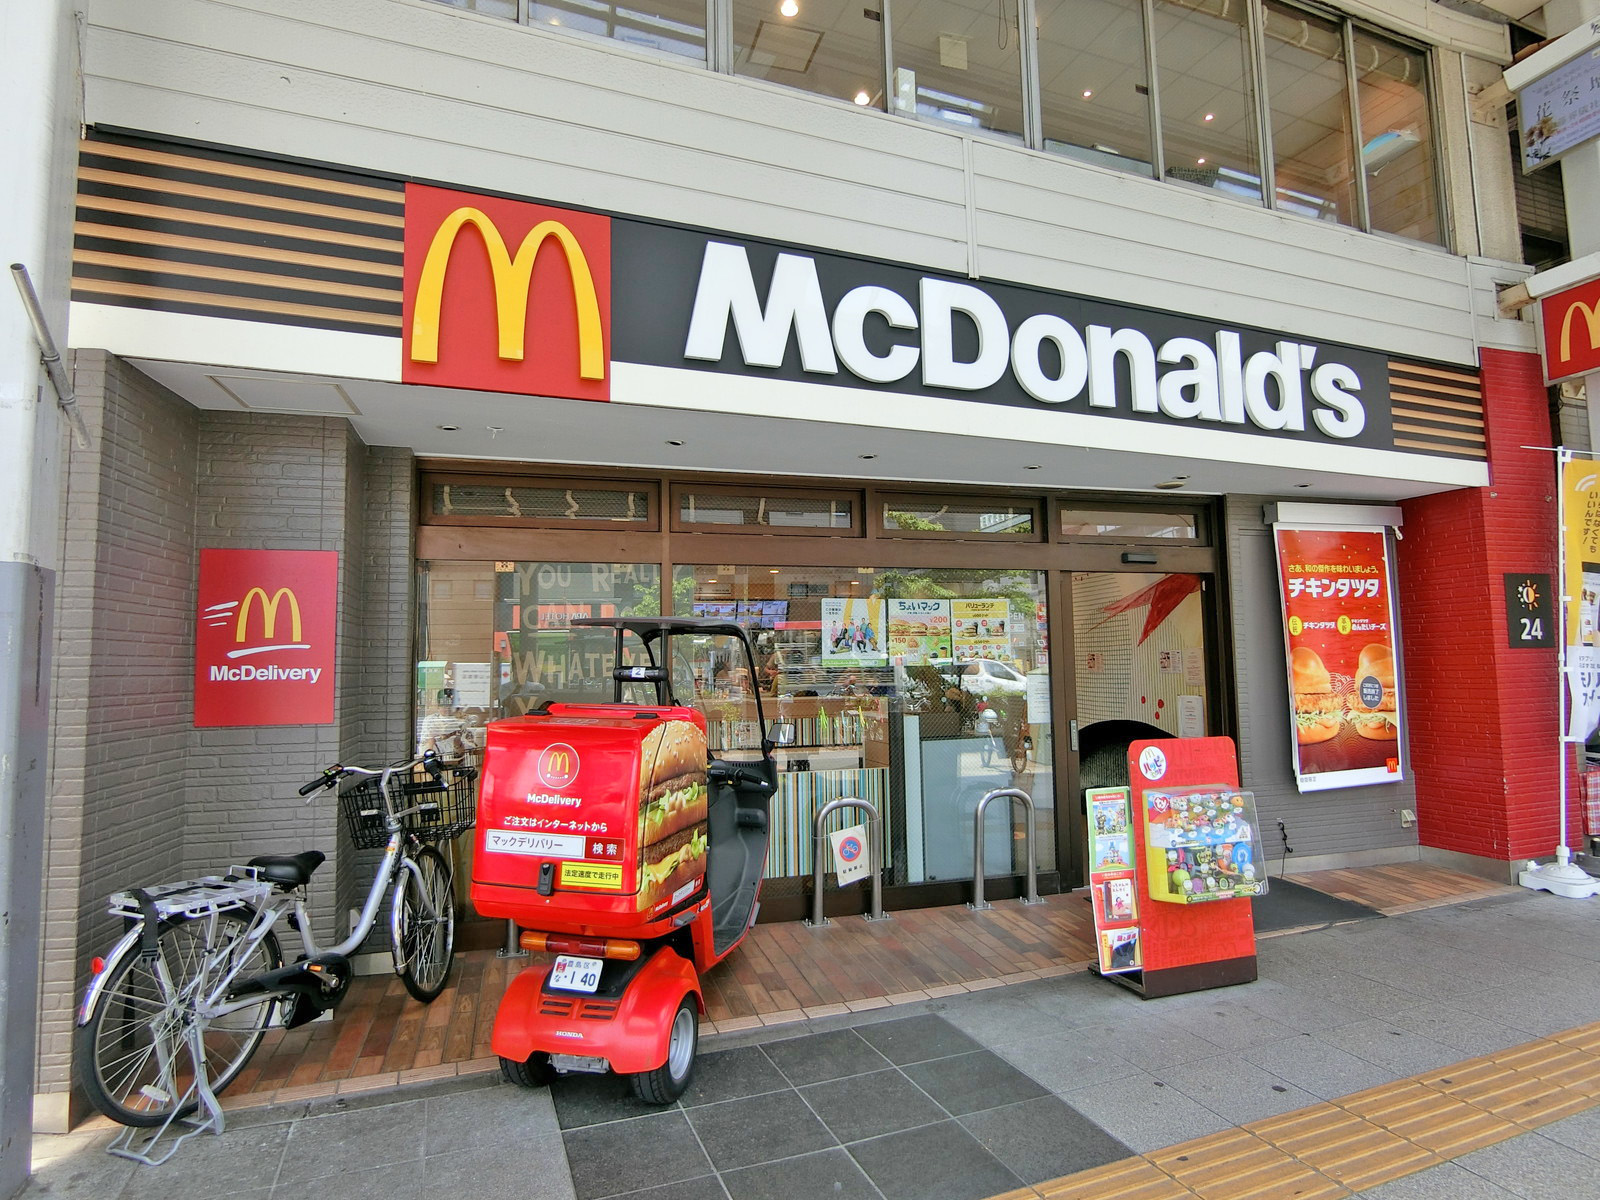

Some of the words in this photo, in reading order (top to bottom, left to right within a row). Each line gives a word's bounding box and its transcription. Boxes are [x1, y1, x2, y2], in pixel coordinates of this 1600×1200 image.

[684, 240, 1366, 439] McDonald's
[1288, 577, 1379, 598] チキンタツタ
[898, 601, 940, 611] ちょいマック
[1303, 621, 1336, 629] チキンタツタ
[1520, 618, 1543, 640] 24
[210, 665, 322, 684] McDelivery
[527, 792, 582, 808] McDelivery
[503, 815, 608, 833] ご注文はインターネットから
[492, 835, 564, 849] マックデリバリー
[564, 868, 619, 881] 法定速度で走行中
[556, 1030, 584, 1039] HONDA
